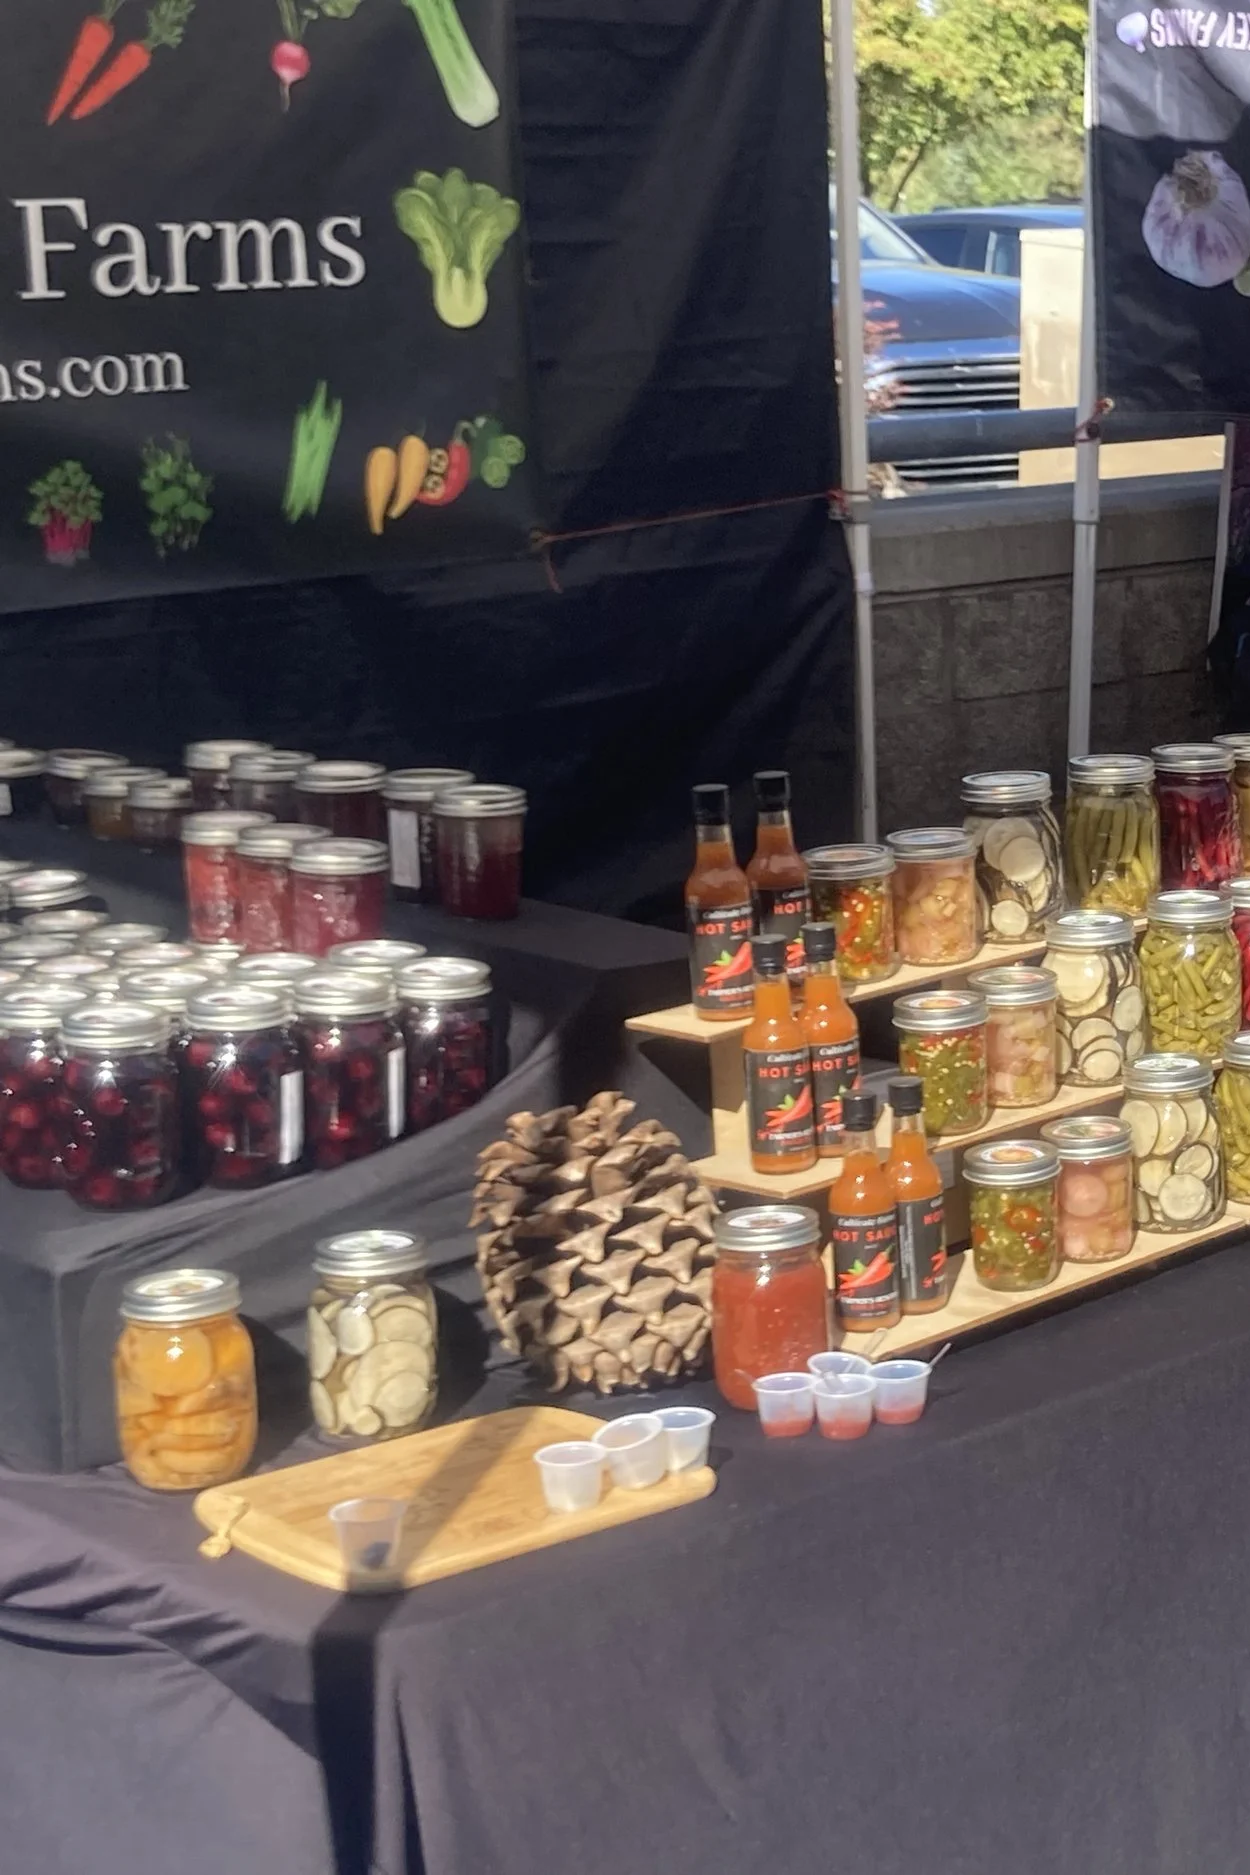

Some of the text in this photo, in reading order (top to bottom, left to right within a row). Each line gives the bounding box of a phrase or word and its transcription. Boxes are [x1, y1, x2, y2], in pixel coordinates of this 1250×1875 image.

[11, 196, 367, 300] Farms
[0, 350, 191, 403] s.com
[758, 1066, 791, 1079] HOT
[812, 1058, 843, 1073] HOT
